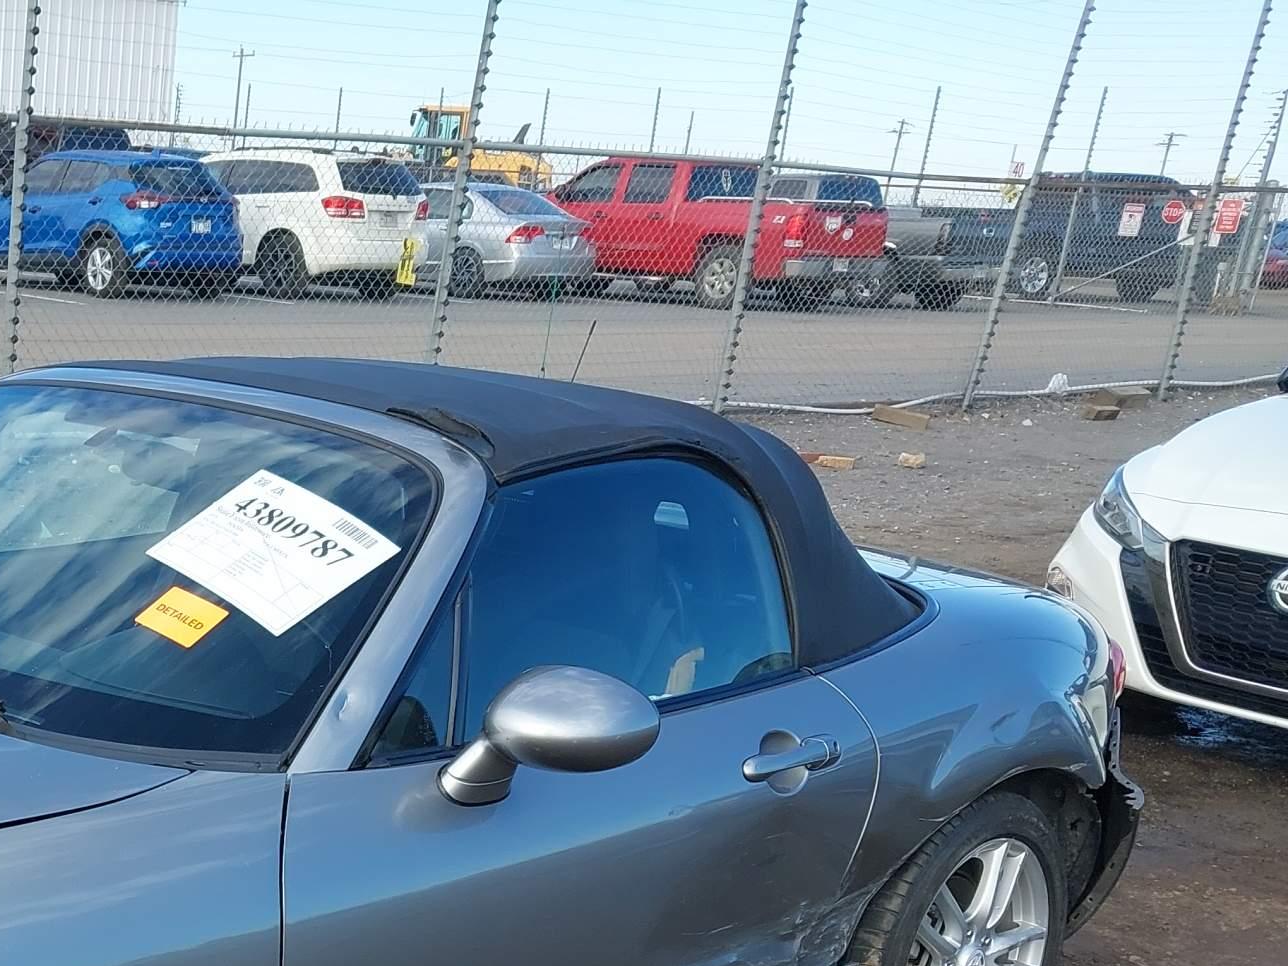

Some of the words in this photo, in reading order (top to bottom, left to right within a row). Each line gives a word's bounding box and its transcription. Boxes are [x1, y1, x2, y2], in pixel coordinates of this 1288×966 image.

[1164, 207, 1184, 217] STOP
[234, 497, 355, 566] 43809787
[155, 603, 205, 630] DETAILED
